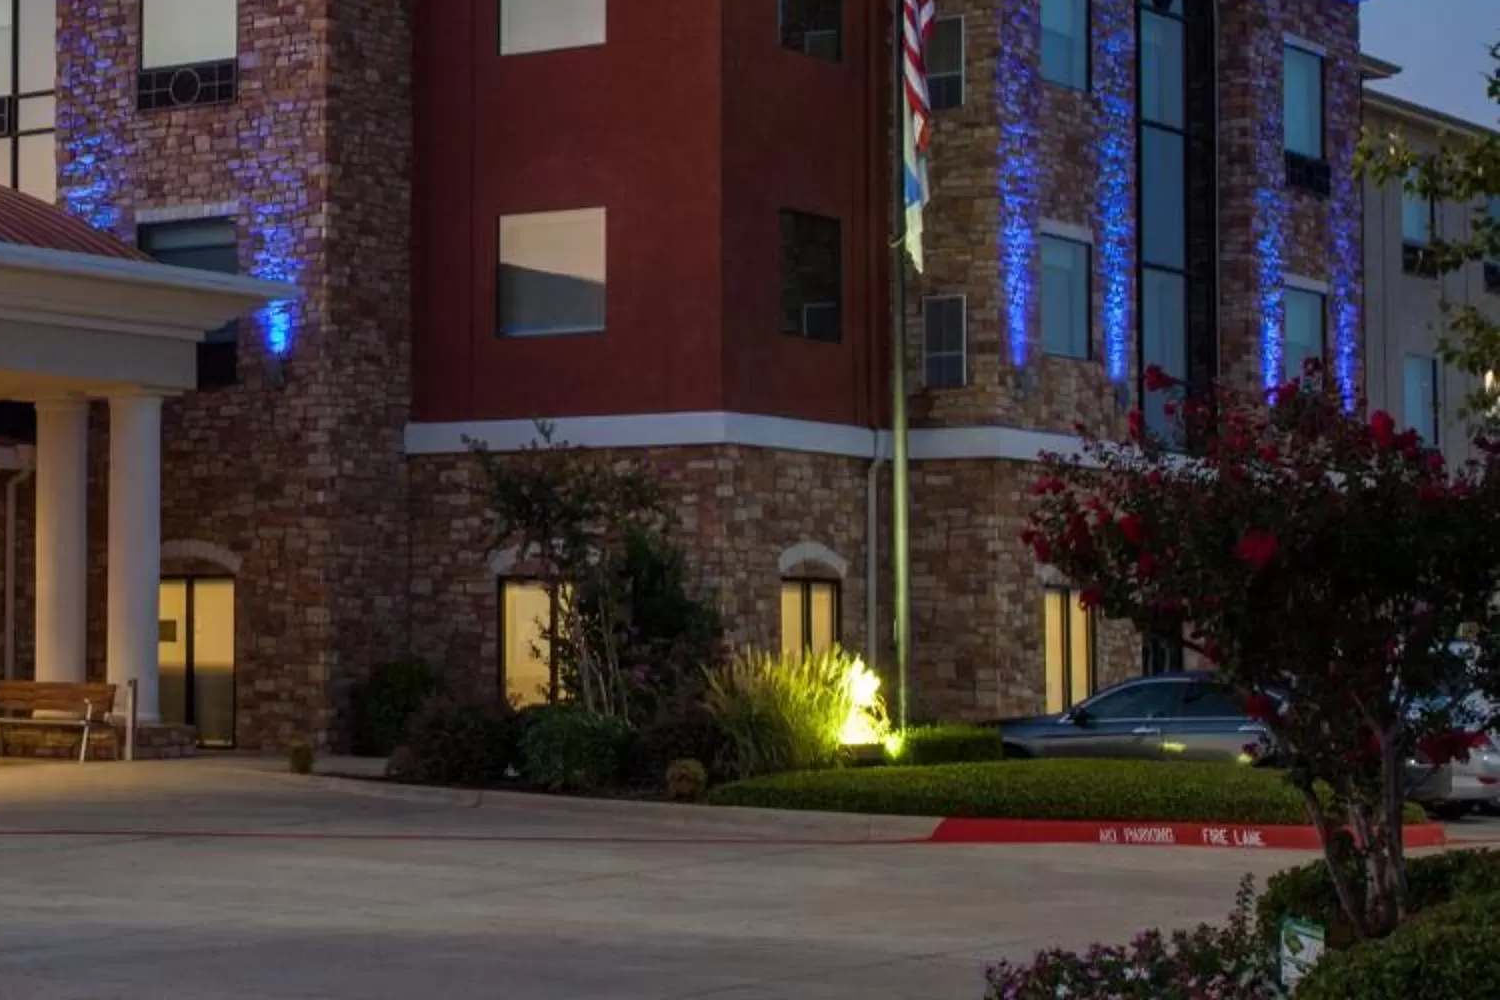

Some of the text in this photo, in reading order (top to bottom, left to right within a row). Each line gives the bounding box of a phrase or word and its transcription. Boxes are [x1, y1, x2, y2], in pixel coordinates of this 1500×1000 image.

[1100, 827, 1265, 846] NO PARKING FIRE LANE
